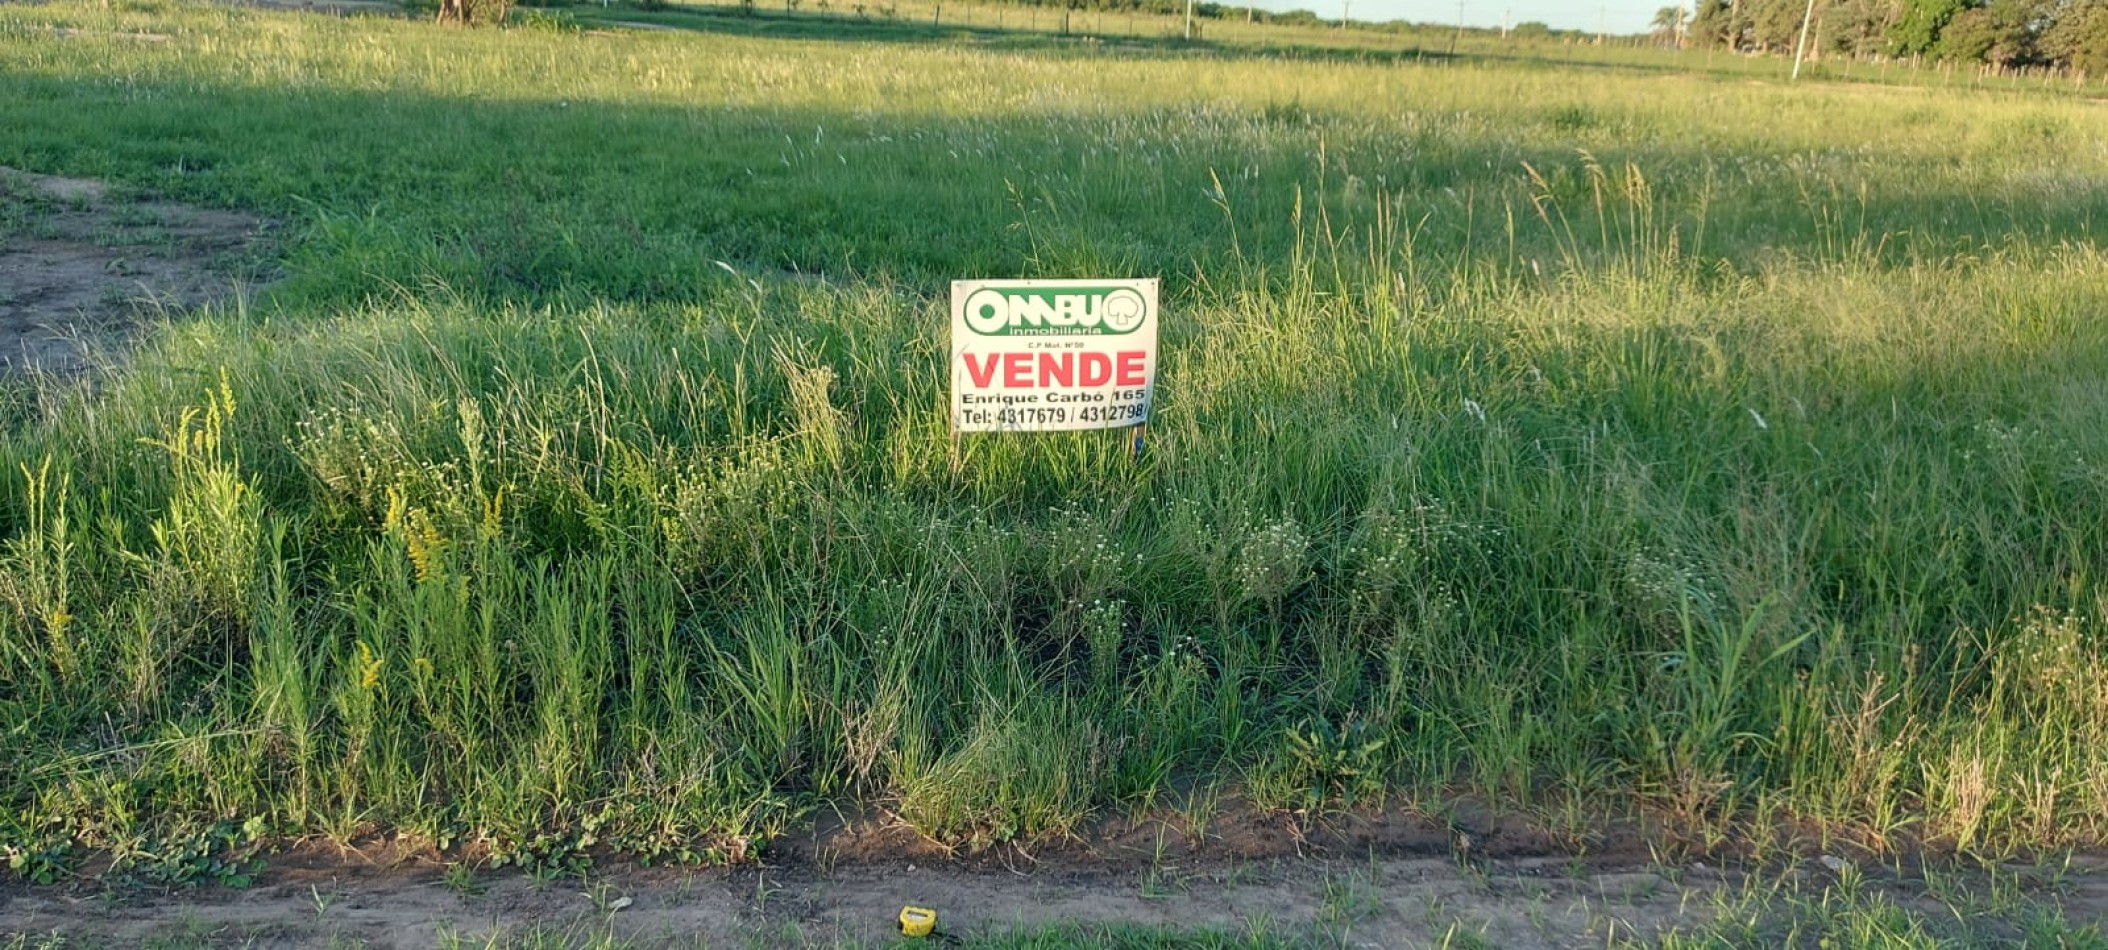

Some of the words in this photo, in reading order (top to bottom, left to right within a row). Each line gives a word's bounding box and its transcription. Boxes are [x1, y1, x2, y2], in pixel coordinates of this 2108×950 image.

[1009, 326, 1102, 336] inmobiliaria
[963, 351, 1147, 389] VENDE
[962, 393, 1039, 405] Enrique
[1046, 391, 1104, 403] Carbó
[1113, 389, 1145, 401] 165
[963, 409, 992, 423] Tel:
[997, 407, 1066, 424] 4317679
[1079, 403, 1143, 422] 4312798
